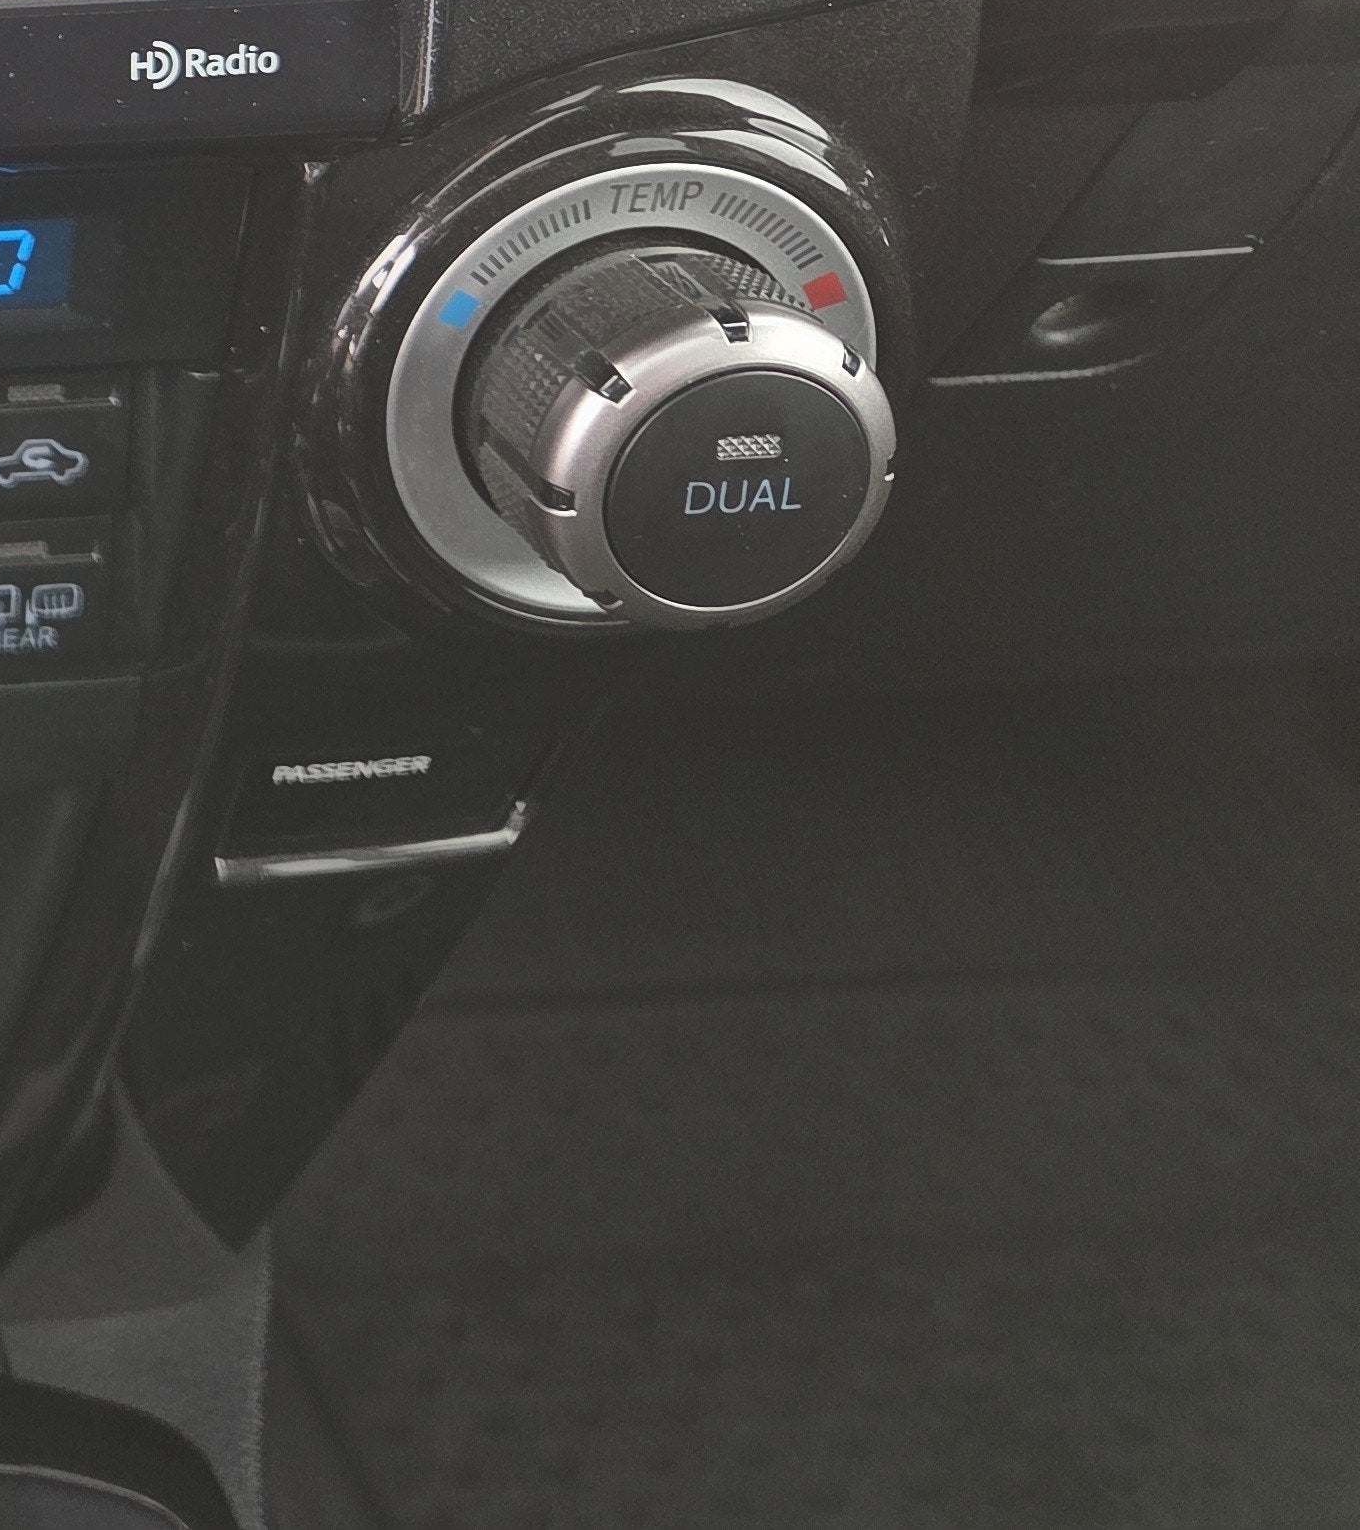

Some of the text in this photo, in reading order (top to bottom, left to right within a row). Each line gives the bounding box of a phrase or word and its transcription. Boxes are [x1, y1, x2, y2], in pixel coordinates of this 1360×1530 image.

[130, 40, 280, 90] HD Radio
[608, 180, 704, 214] TEMP
[684, 478, 802, 515] DUAL
[272, 755, 431, 786] PASSENGER
